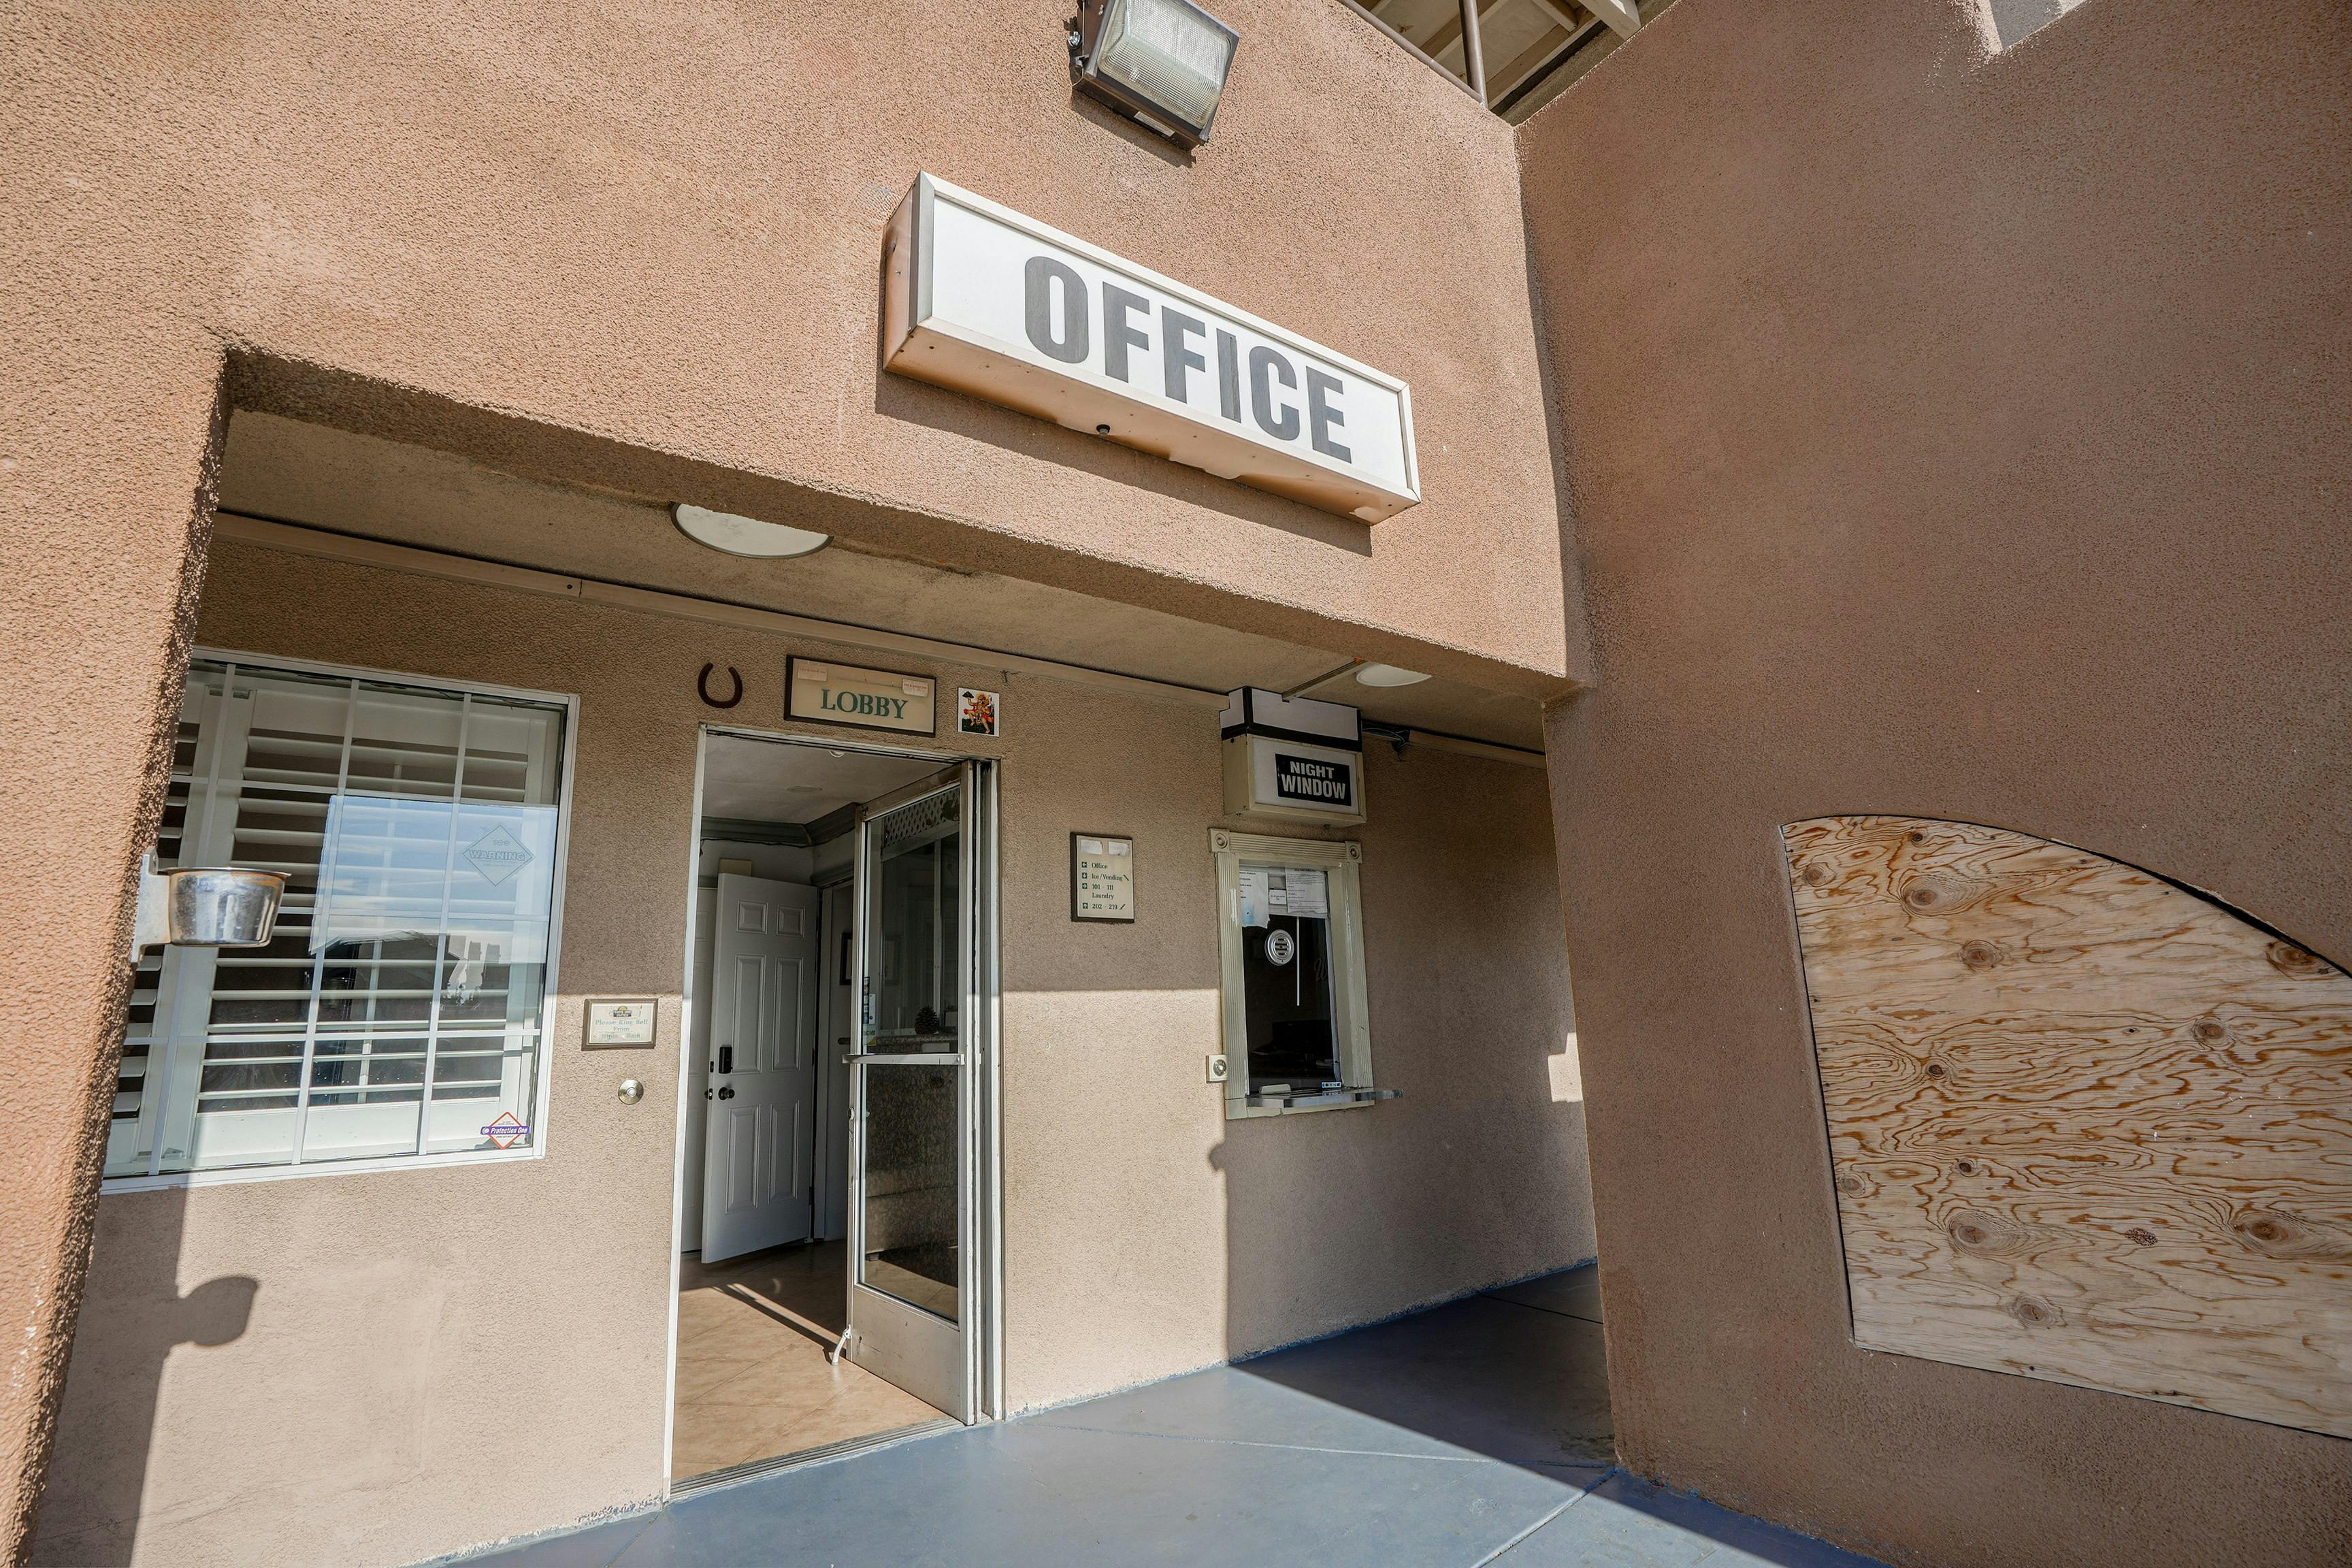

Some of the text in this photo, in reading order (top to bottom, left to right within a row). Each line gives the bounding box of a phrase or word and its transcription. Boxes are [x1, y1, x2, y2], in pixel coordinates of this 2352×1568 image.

[1024, 256, 1352, 463] OFFICE
[820, 689, 909, 719] LOBBY
[1290, 761, 1335, 779] NIGHT
[1281, 774, 1345, 800] WINDOW
[469, 849, 525, 861] WARNING
[1092, 873, 1123, 881] Ice/Vending
